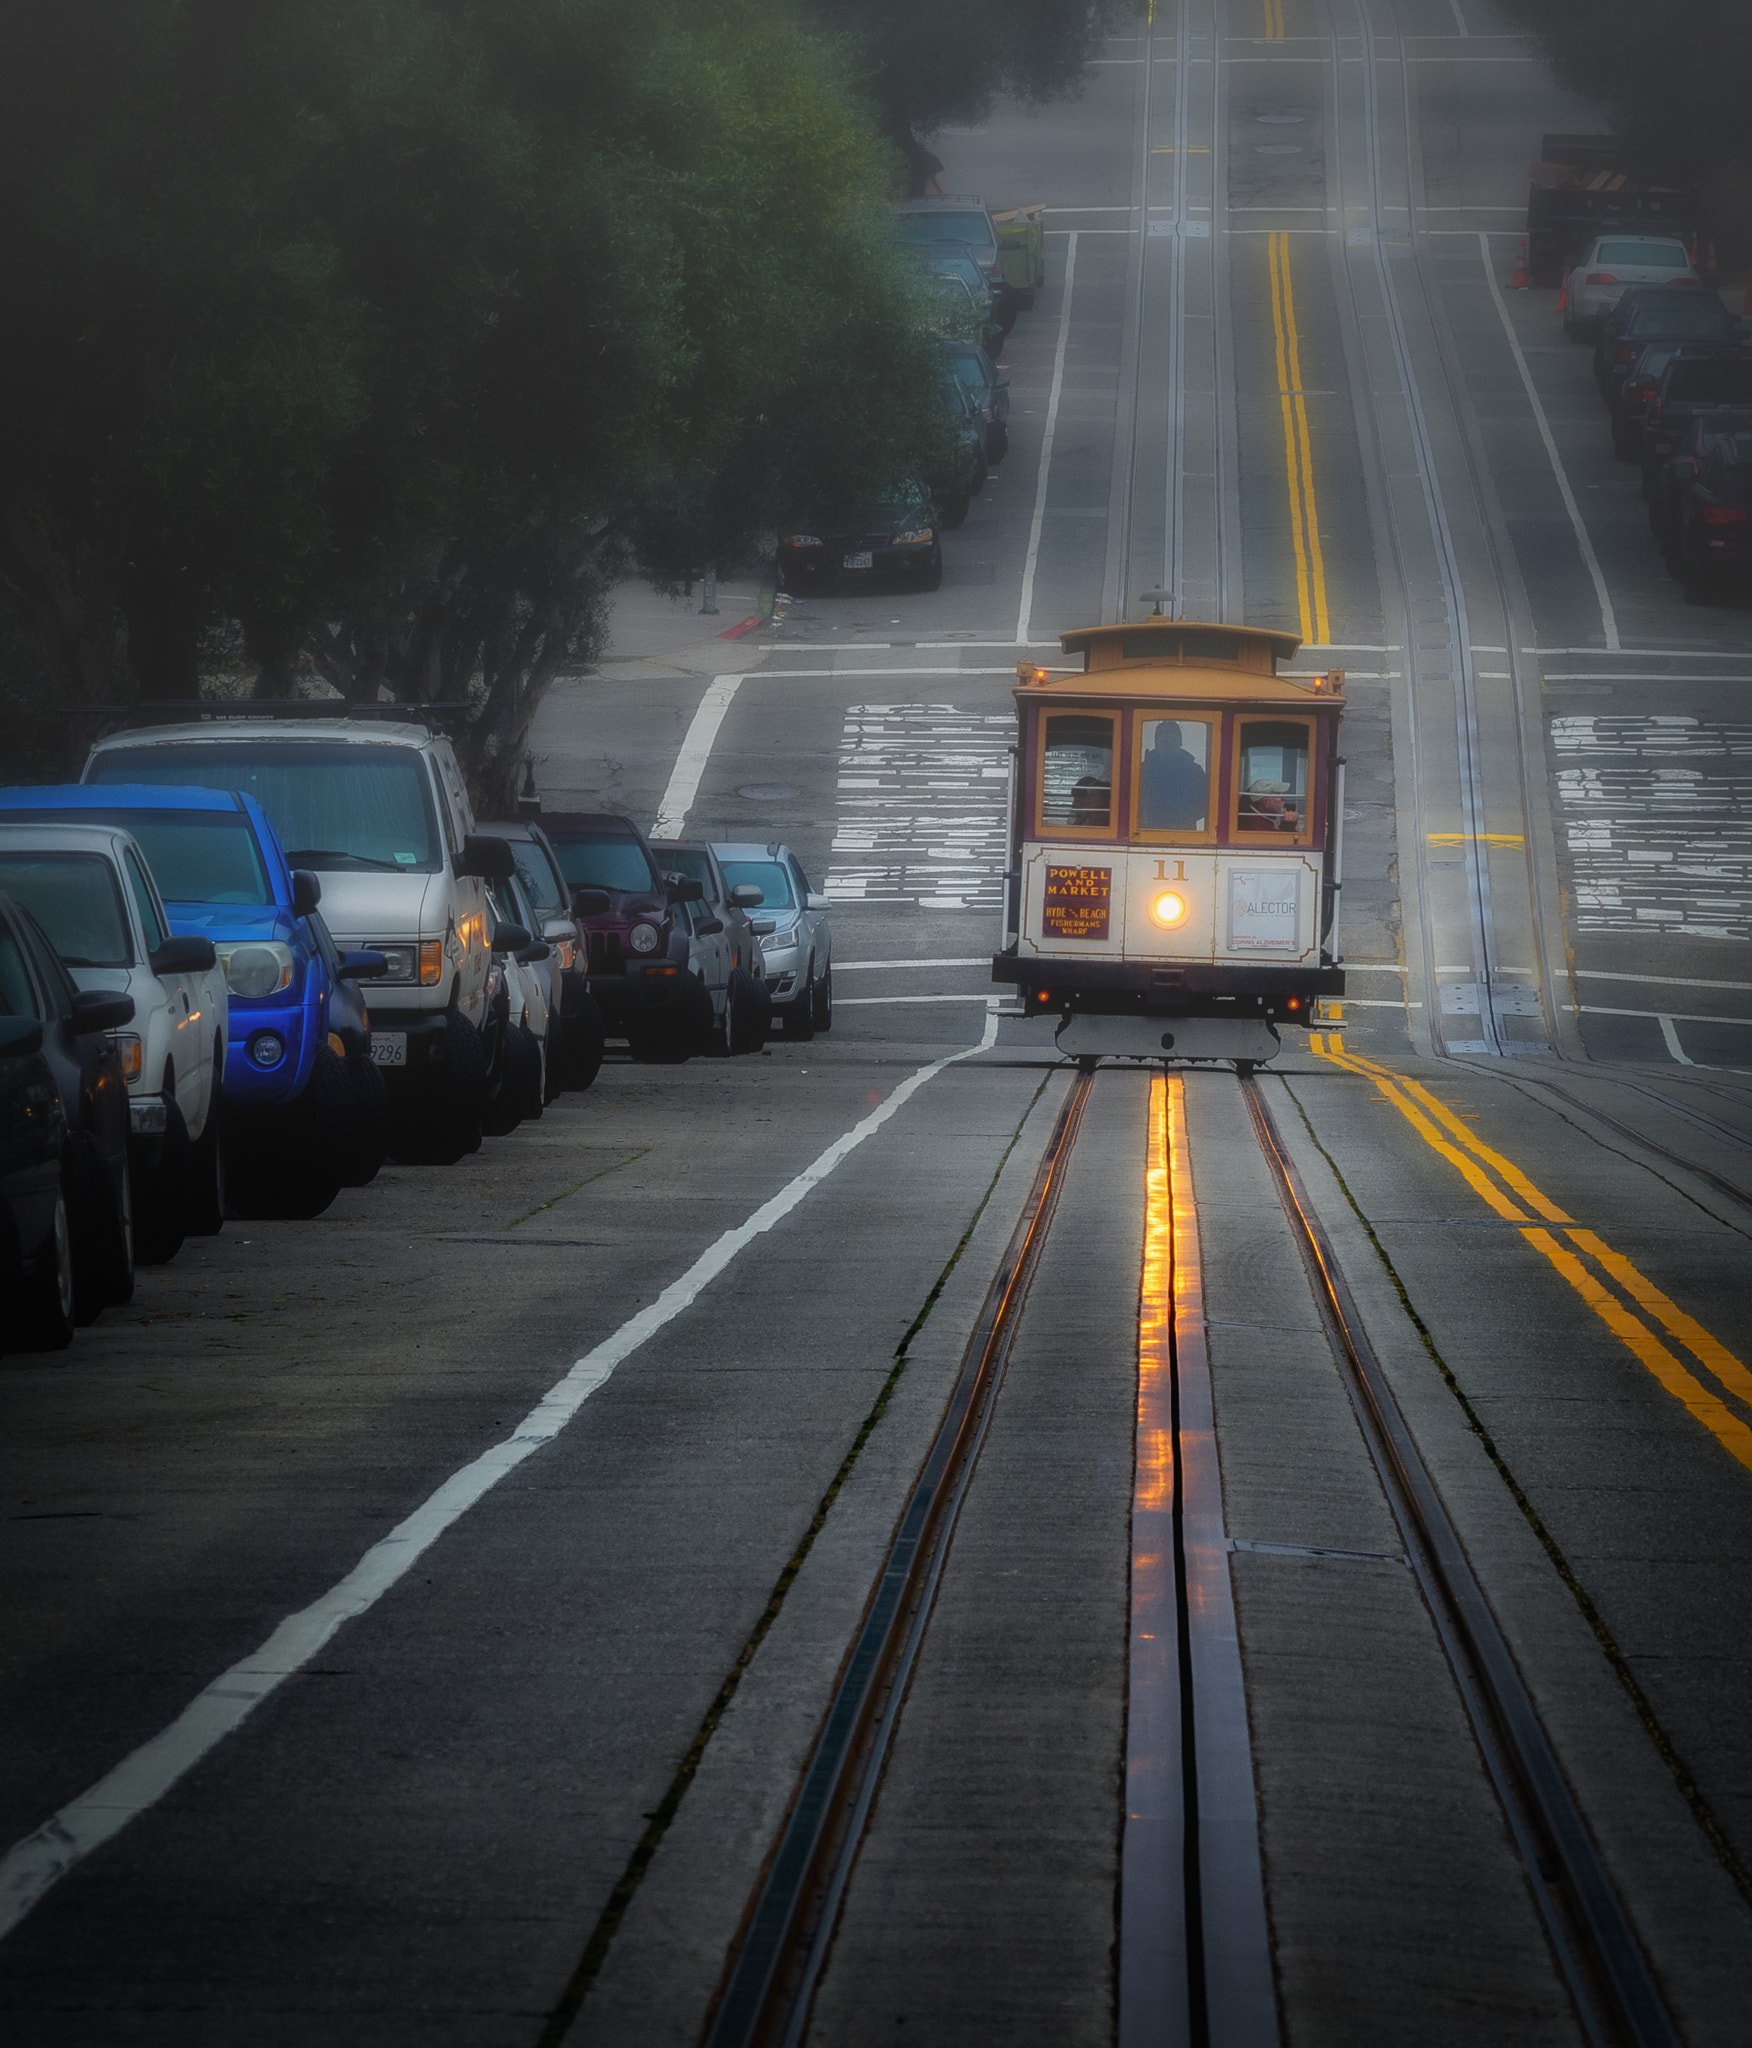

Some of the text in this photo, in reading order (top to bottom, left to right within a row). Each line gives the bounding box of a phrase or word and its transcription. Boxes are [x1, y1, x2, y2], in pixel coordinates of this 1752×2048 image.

[1050, 869, 1109, 879] POWELL
[1153, 859, 1189, 881] 11
[1048, 886, 1109, 896] MARKET
[1046, 907, 1066, 918] HYDE
[1247, 902, 1296, 914] ALECTOR
[1050, 919, 1101, 928] FISHERMANS
[1062, 927, 1088, 935] WHARF
[370, 1045, 402, 1060] 9296
